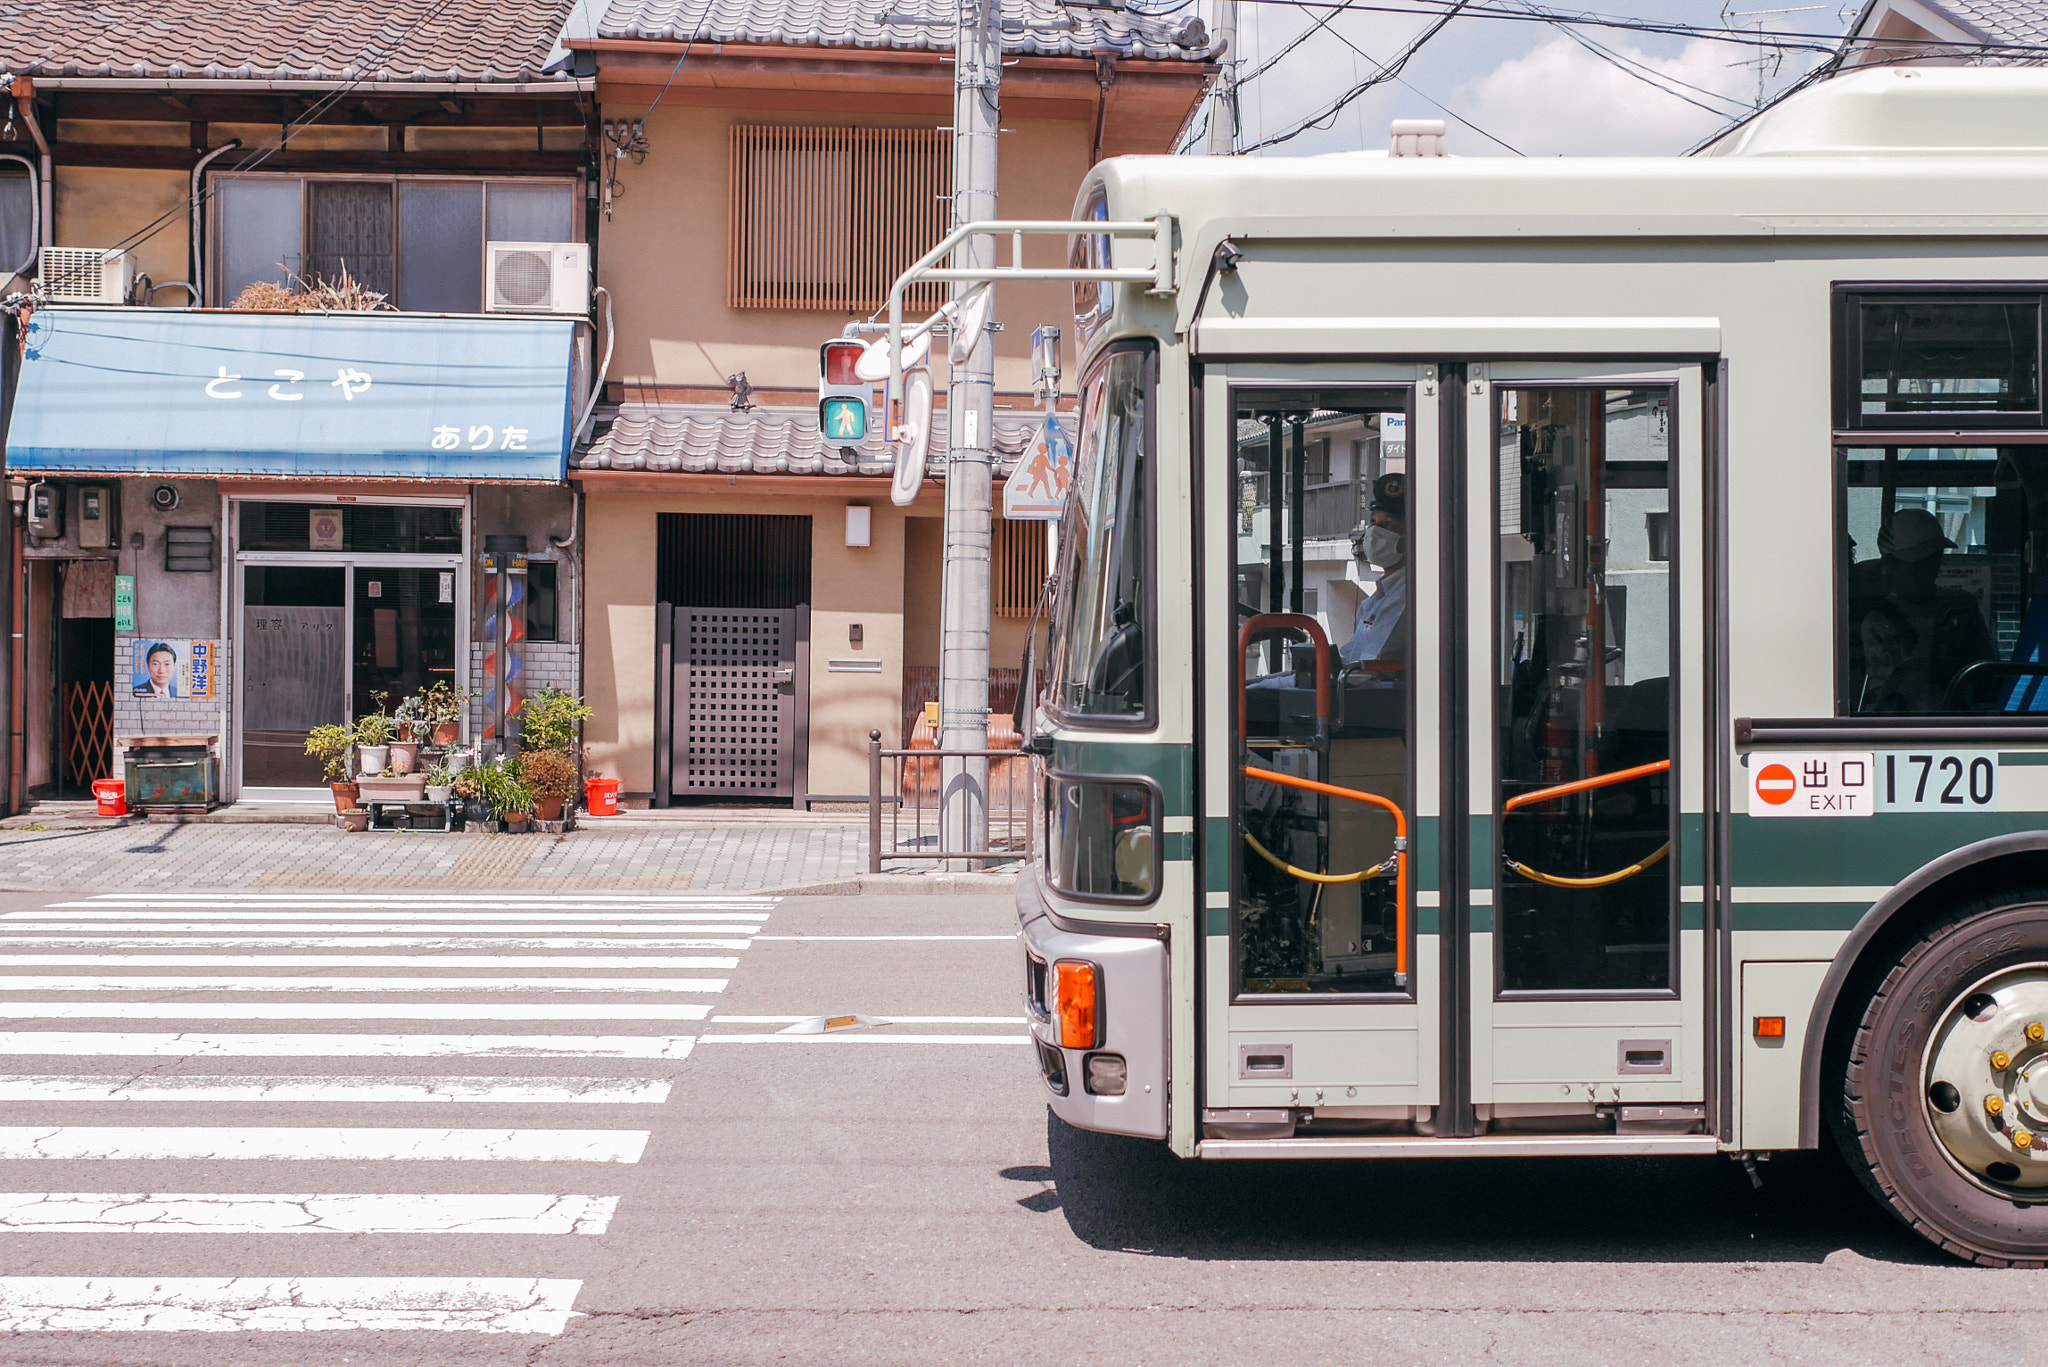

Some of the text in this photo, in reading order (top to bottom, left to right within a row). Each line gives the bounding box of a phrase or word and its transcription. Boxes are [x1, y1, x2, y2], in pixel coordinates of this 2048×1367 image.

[205, 366, 372, 401] とこや
[431, 424, 529, 451] ありた
[117, 595, 132, 603] こども
[256, 618, 333, 632] 理容 アリタ
[191, 643, 208, 696] 中野洋一
[1803, 759, 1865, 788] 出口
[1886, 754, 1994, 805] 1720
[1810, 795, 1857, 810] EXIT
